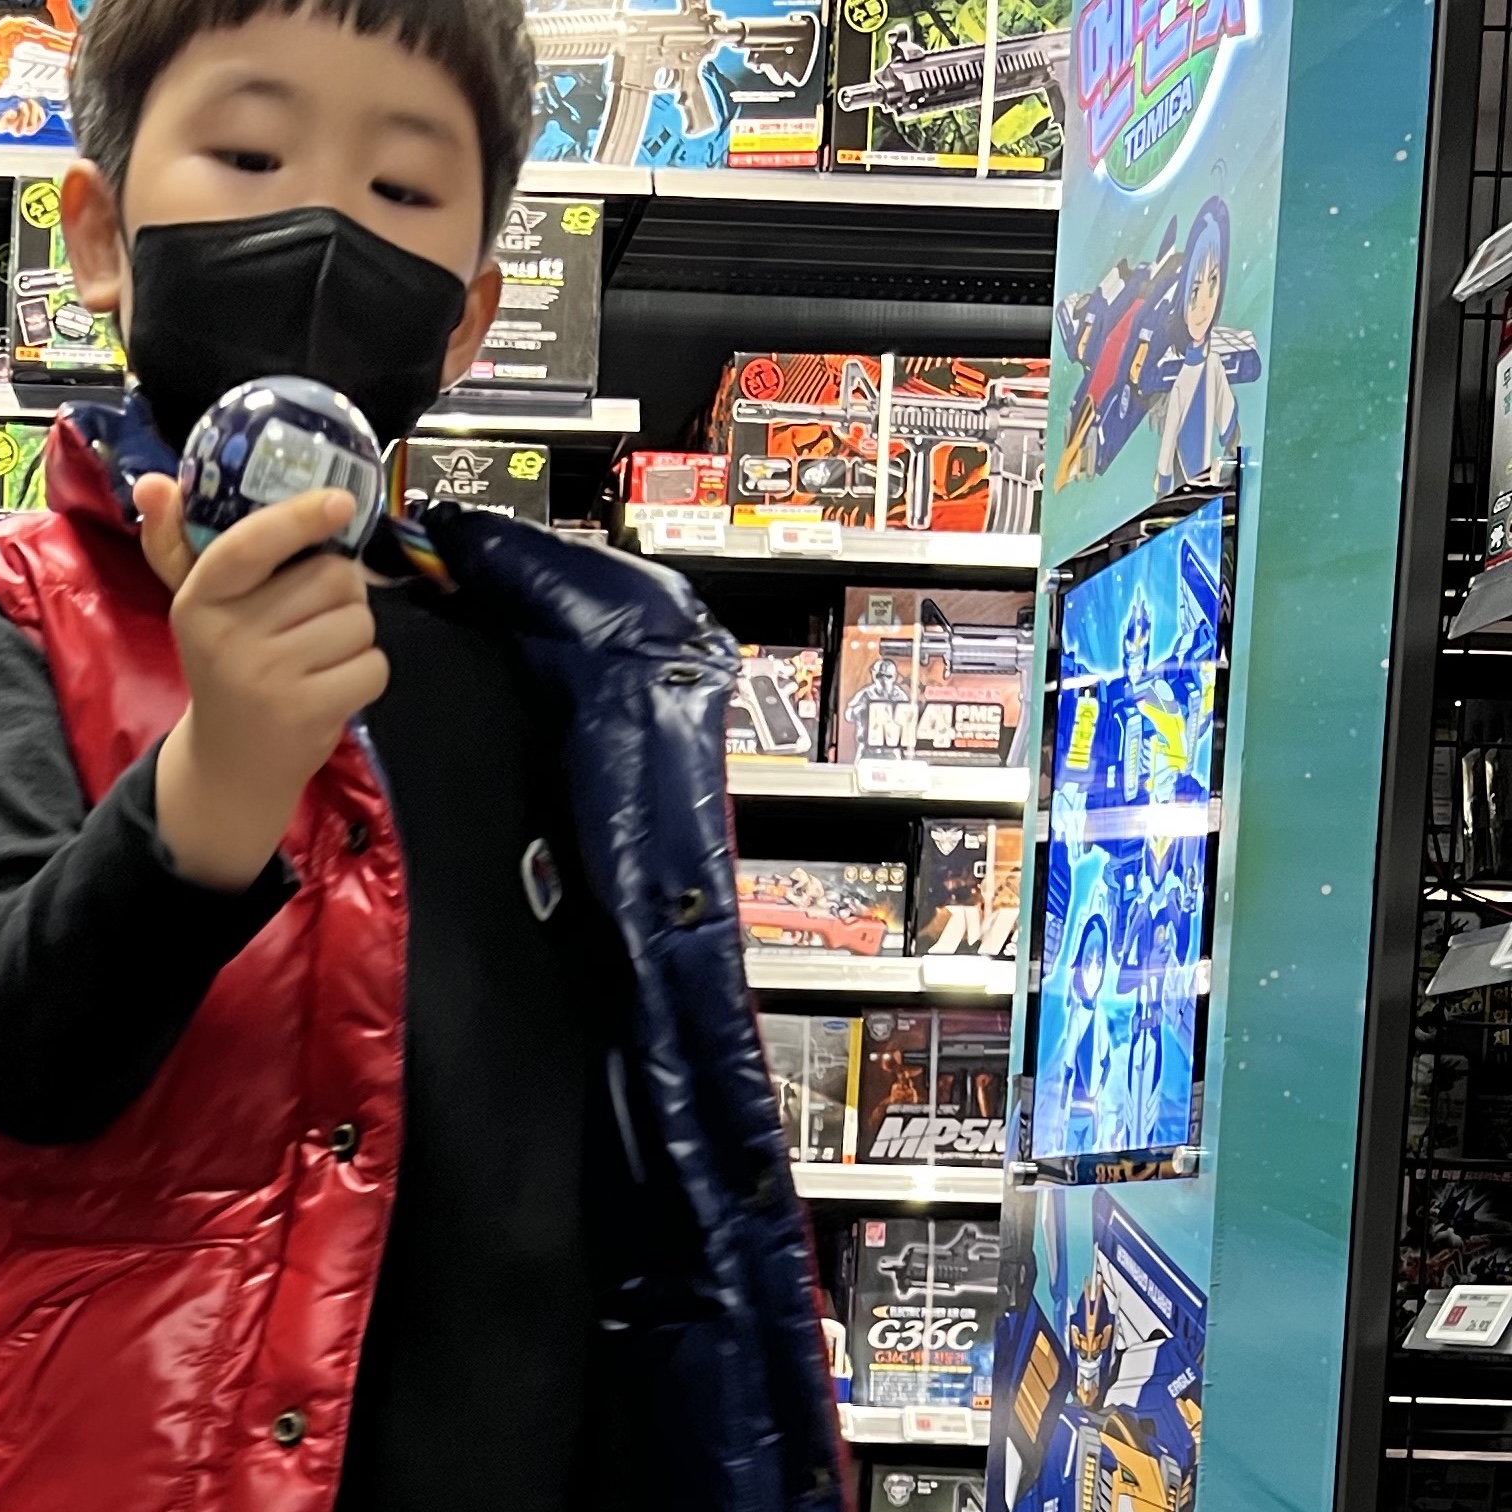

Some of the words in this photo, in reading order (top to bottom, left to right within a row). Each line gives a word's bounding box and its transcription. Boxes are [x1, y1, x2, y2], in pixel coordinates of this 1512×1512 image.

[1123, 73, 1194, 170] TOMICA
[435, 479, 489, 494] AGF
[867, 1319, 979, 1351] G36C
[1167, 1366, 1197, 1398] EAGLE
